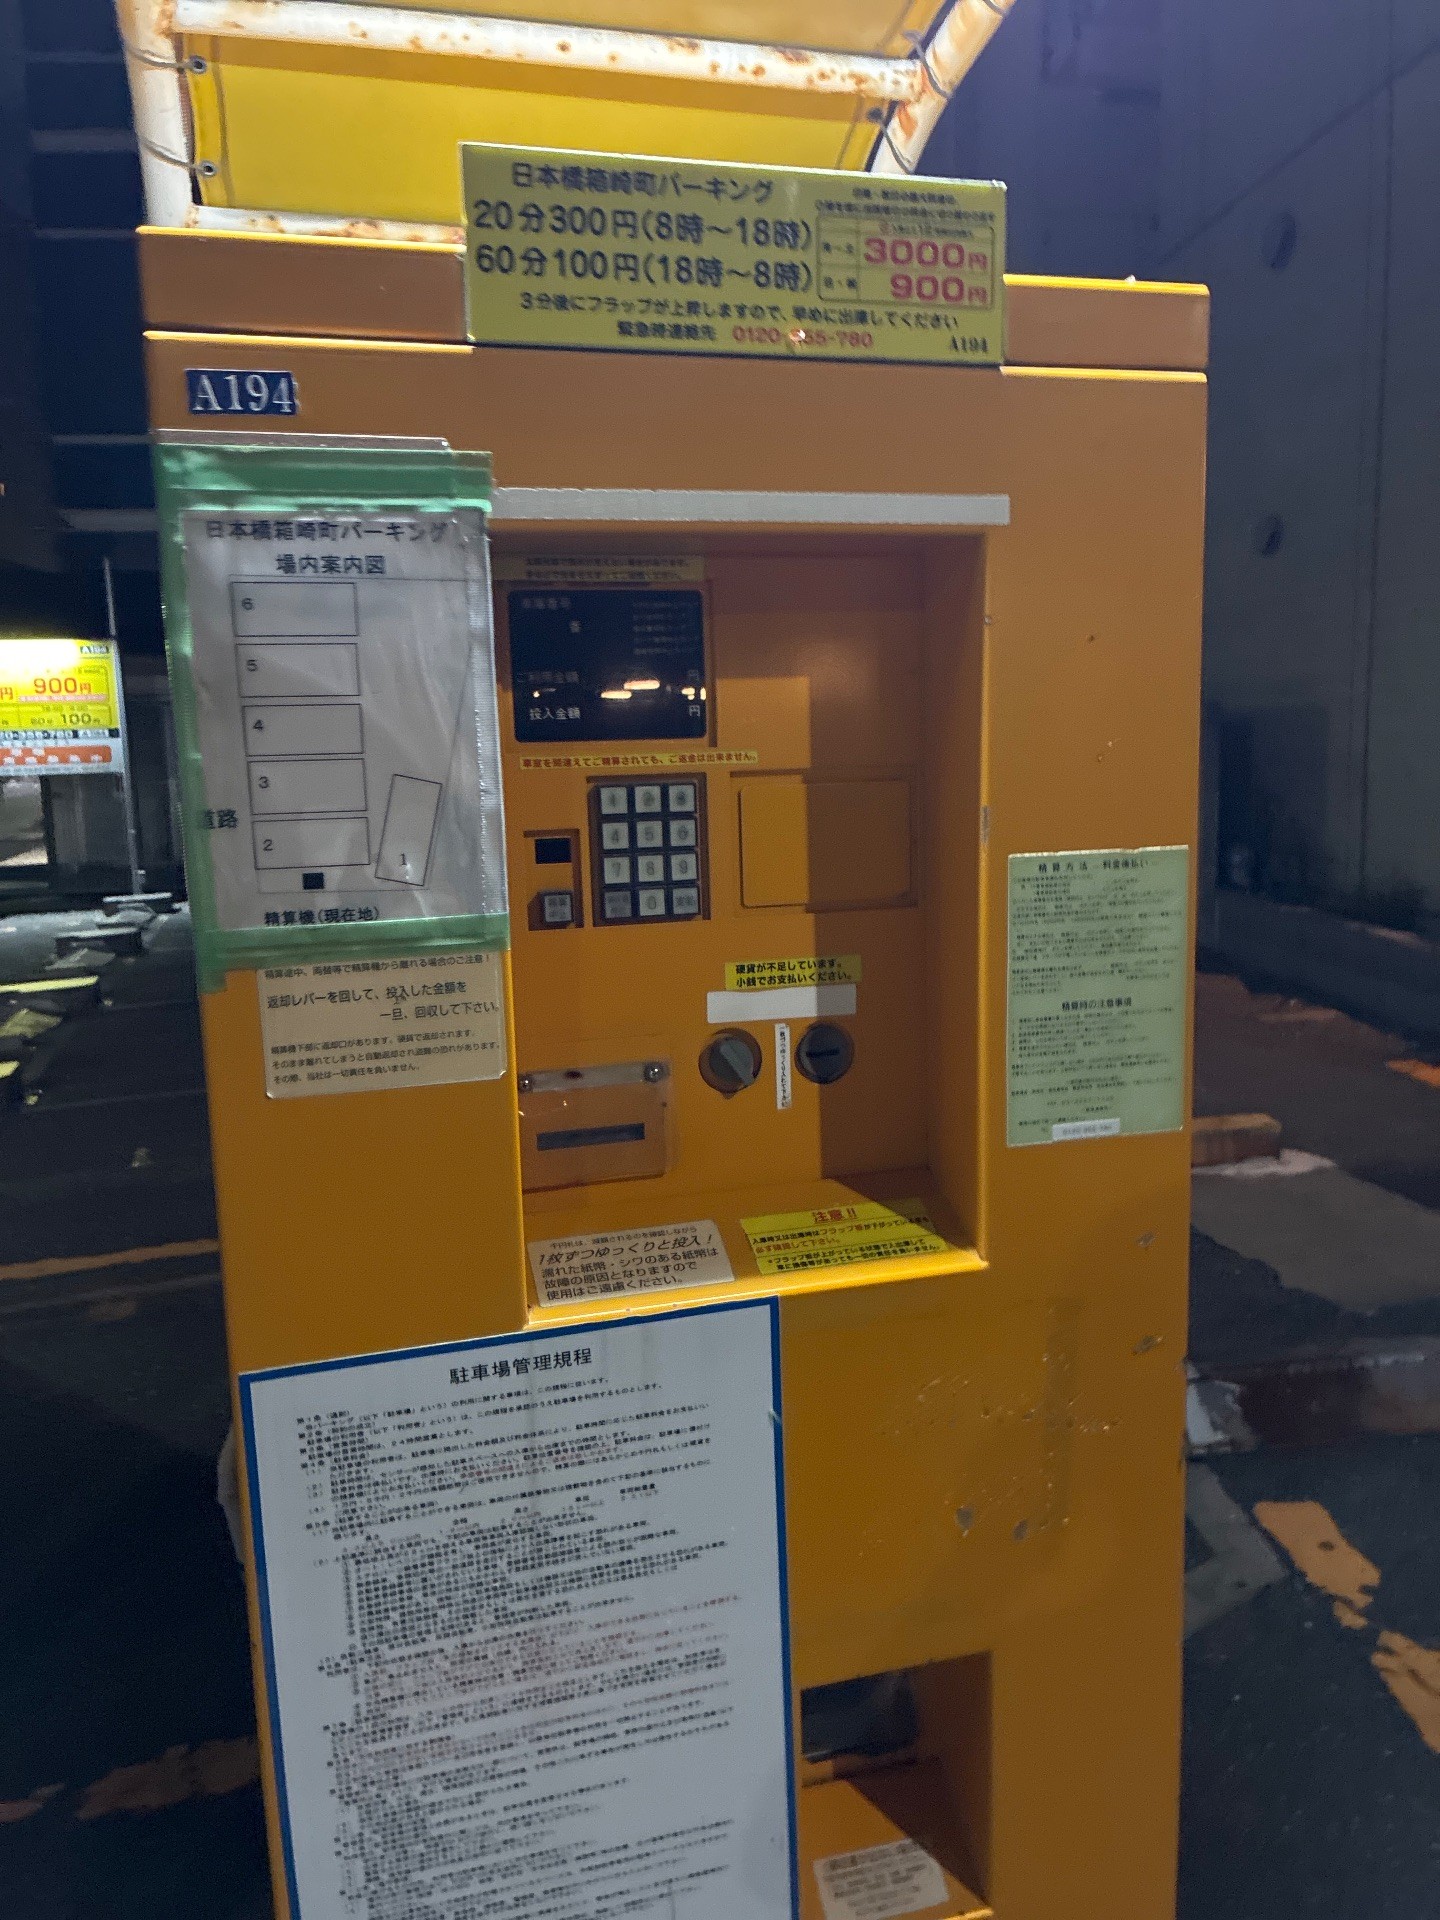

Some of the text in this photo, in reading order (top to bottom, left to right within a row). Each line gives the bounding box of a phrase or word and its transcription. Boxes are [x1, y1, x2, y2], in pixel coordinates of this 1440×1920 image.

[864, 237, 988, 270] 3000円
[890, 273, 988, 302] 900円
[191, 374, 294, 413] A194
[276, 554, 386, 574] 場内案内図
[242, 598, 253, 610] 6
[247, 660, 258, 672] 5
[34, 677, 92, 695] 900円
[529, 707, 581, 720] 投入金額
[252, 719, 264, 732] 4
[258, 776, 269, 790] 3
[262, 839, 273, 851] 2
[400, 853, 408, 866] 1
[736, 959, 842, 974] 硬貨が不足しています。
[267, 981, 467, 1009] 返却レバーを回して、投入した金額を
[380, 1001, 500, 1021] 一旦、回収して下さい。
[542, 1247, 719, 1279] 濡れた紙幣・シワのある紙幣は
[544, 1260, 698, 1290] 故障の原因となりますので
[547, 1275, 683, 1301] 使用はご遠慮ください。
[449, 1347, 593, 1386] 駐車場管理規程
